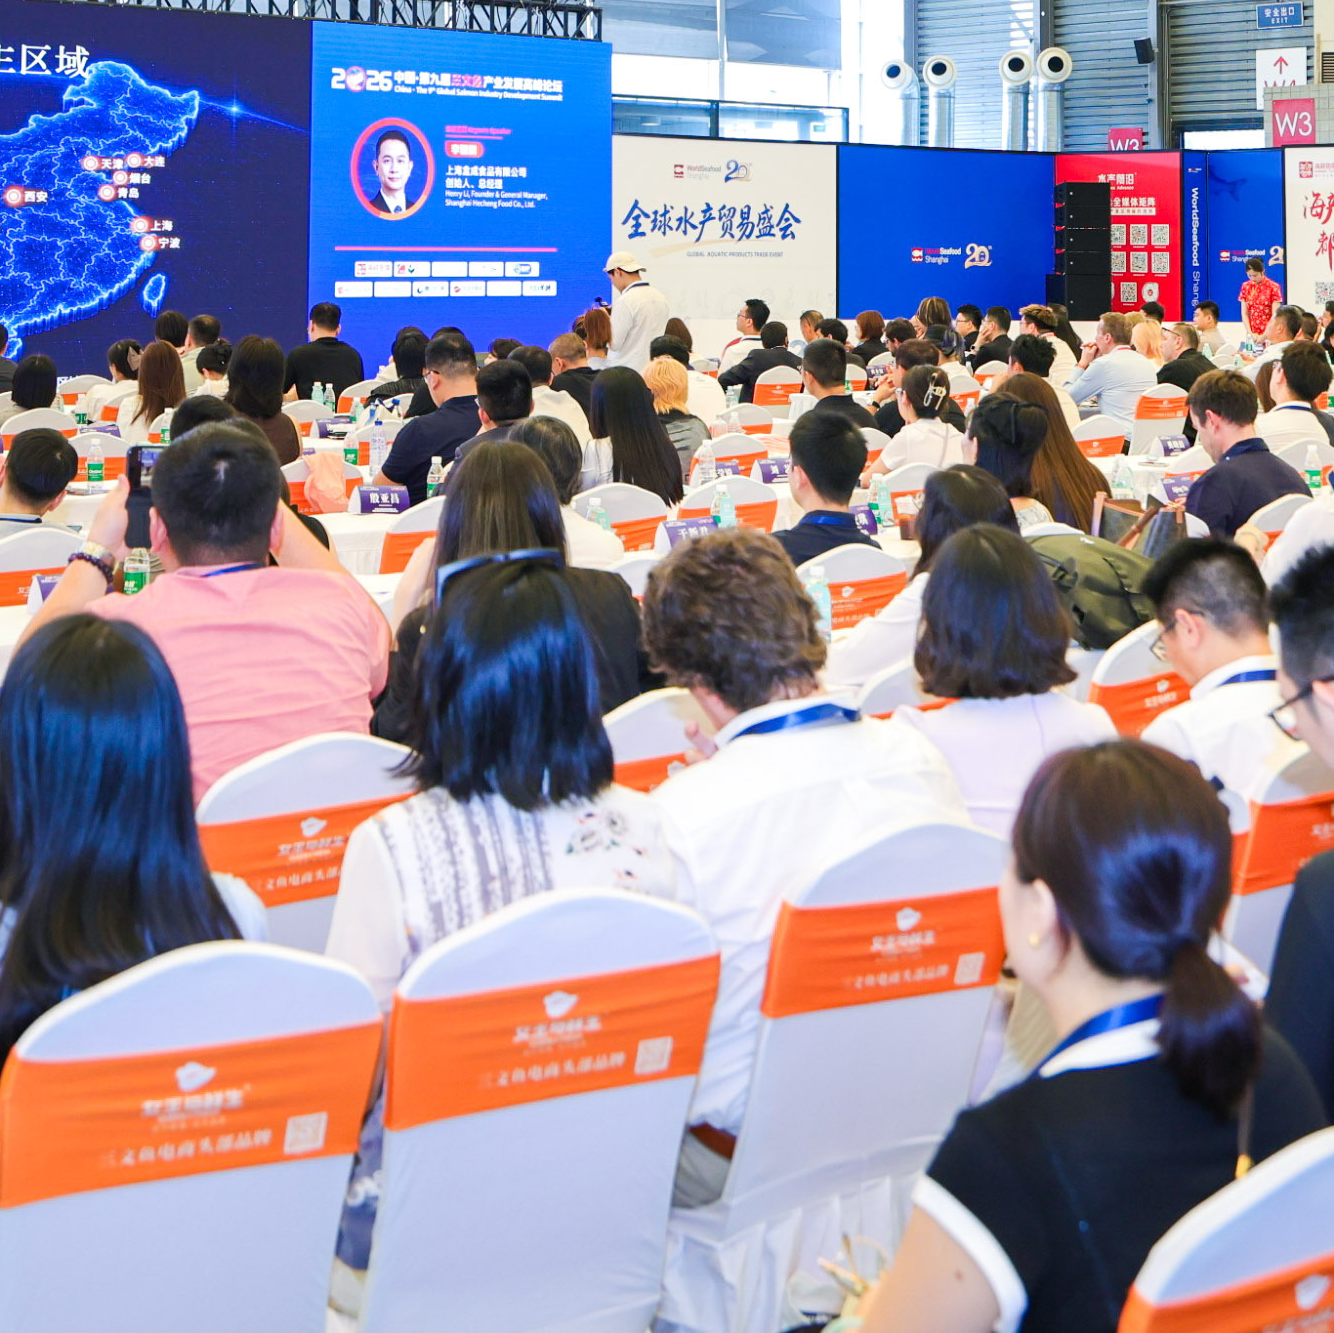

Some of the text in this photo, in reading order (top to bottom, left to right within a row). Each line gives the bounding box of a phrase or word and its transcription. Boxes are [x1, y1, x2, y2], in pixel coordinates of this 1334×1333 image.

[1264, 7, 1295, 18] 安全出口
[1271, 17, 1288, 25] EXIT
[1275, 112, 1313, 138] W3
[101, 158, 123, 169] 天津
[144, 156, 165, 167] 大连
[129, 173, 151, 184] 烟台
[24, 191, 48, 203] 西安
[117, 187, 139, 198] 青岛
[445, 190, 463, 199] Henry
[471, 191, 493, 200] Founder
[501, 192, 522, 200] General
[445, 199, 472, 208] Shanghai
[498, 200, 513, 208] Food
[150, 220, 173, 231] 上海
[621, 199, 802, 243] 全球水产贸易盛会
[1191, 187, 1200, 266] WorldSeafood
[159, 238, 180, 249] 宁波
